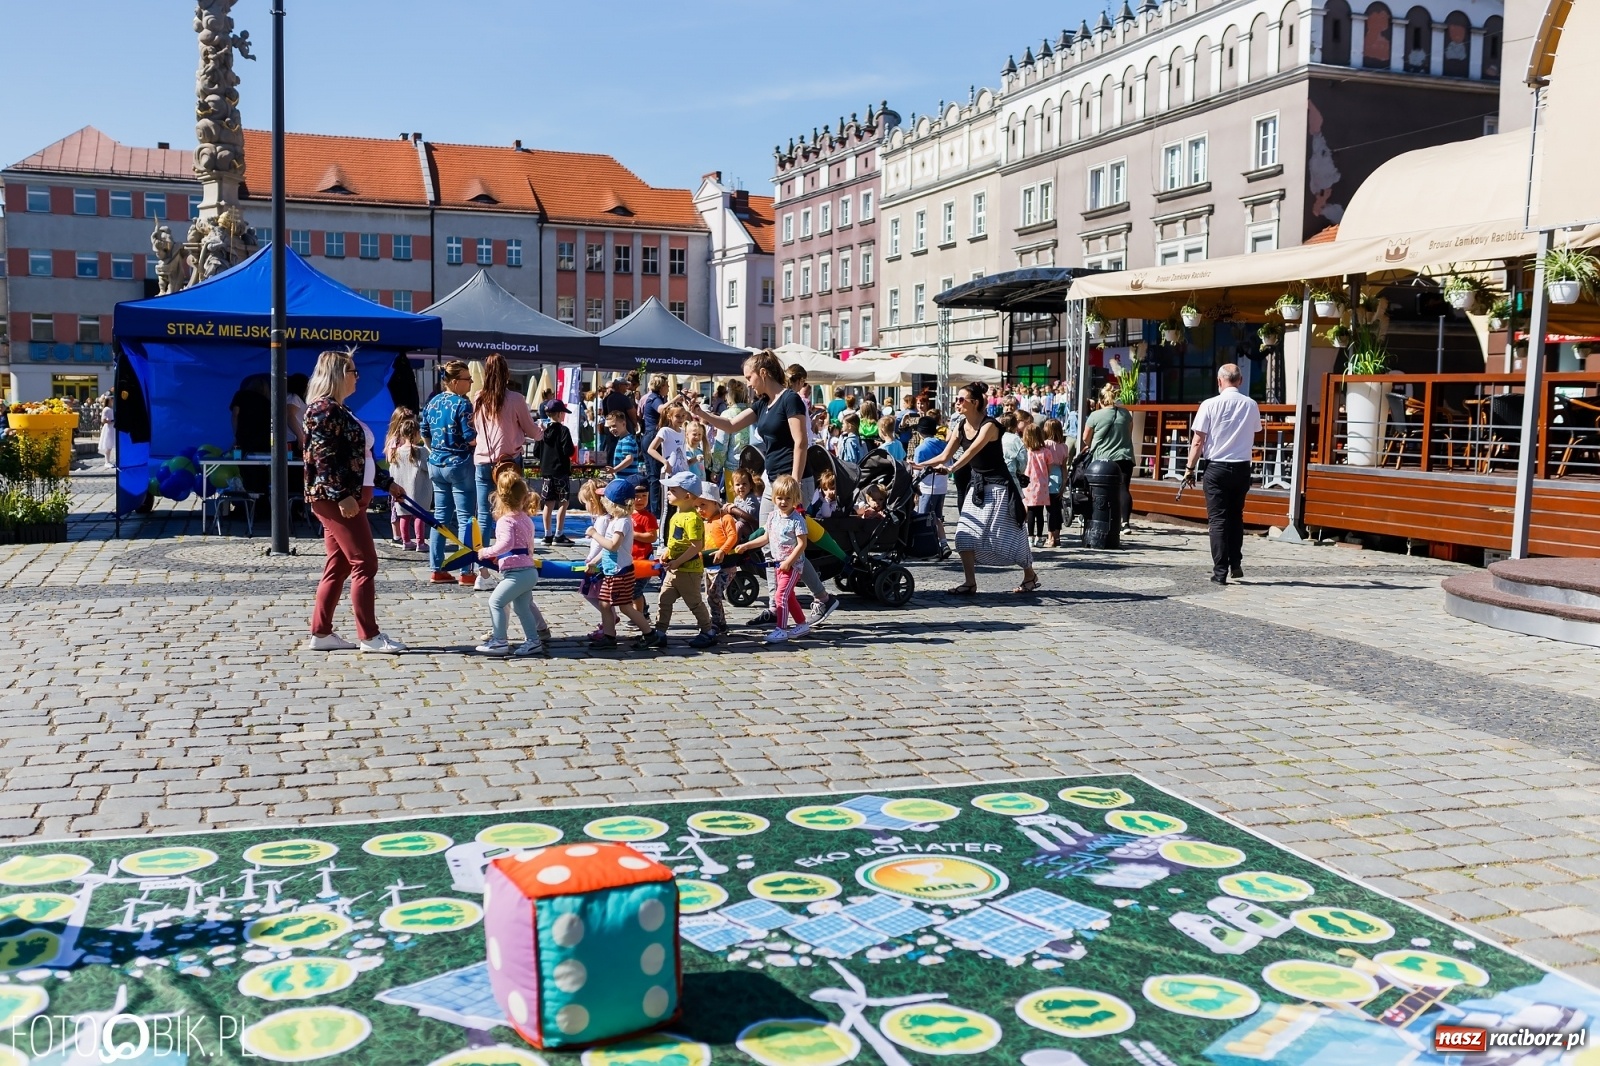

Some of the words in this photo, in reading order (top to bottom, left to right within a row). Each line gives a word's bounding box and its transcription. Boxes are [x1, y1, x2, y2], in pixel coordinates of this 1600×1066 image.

[1429, 239, 1453, 250] Browar
[1454, 234, 1490, 247] Zamkowy
[1491, 230, 1525, 243] Racibórz
[167, 321, 214, 336] STRAŻ
[218, 325, 272, 339] MIEJSK
[285, 328, 297, 339] W
[301, 328, 380, 342] RACIBORZU
[457, 339, 539, 353] www.raciborz.pl
[635, 355, 702, 367] www.raciborz.pl
[795, 851, 850, 868] EKO
[855, 842, 1003, 857] BOHATER
[914, 881, 979, 893] meta
